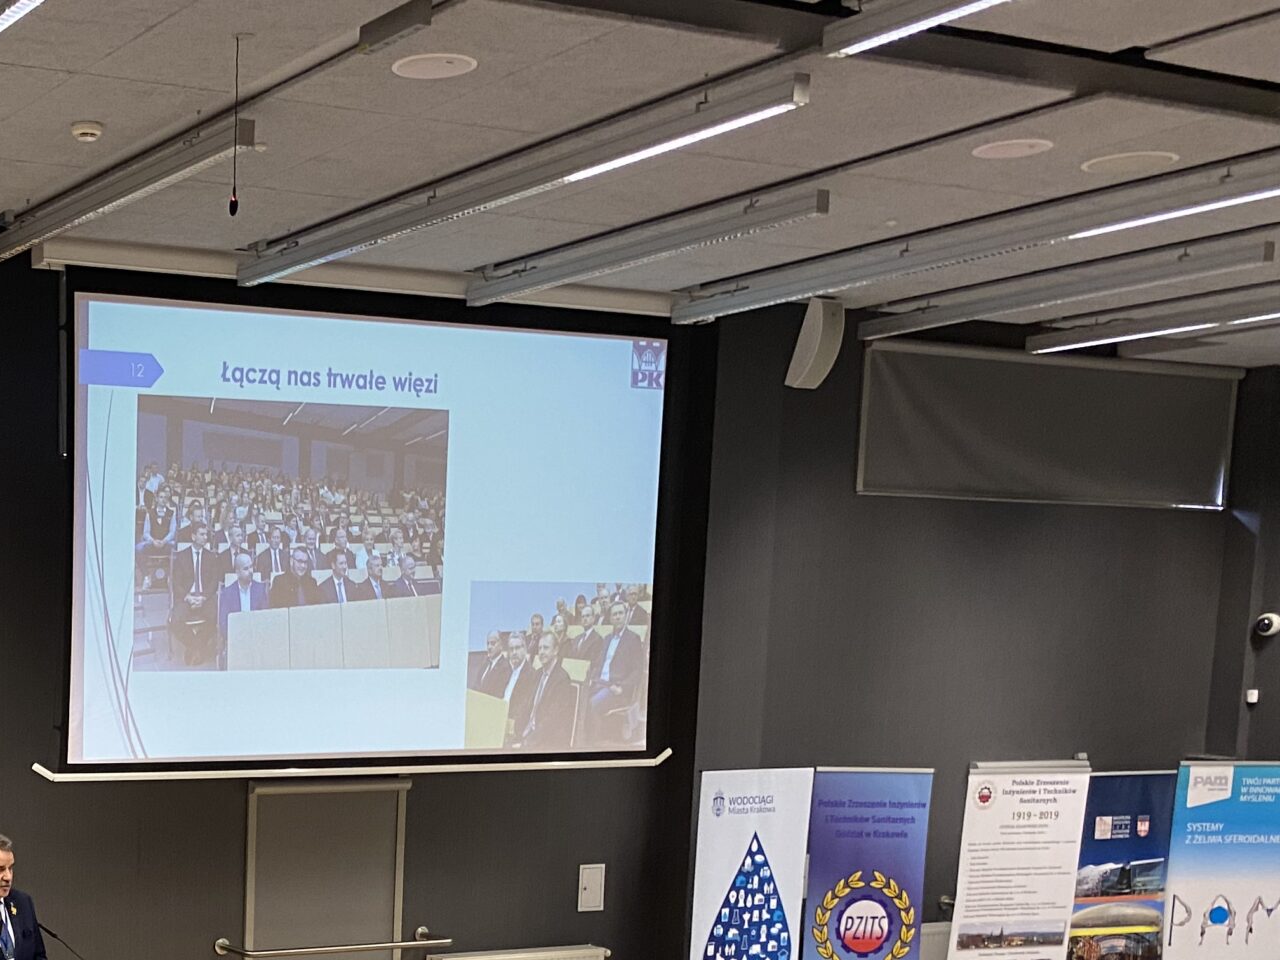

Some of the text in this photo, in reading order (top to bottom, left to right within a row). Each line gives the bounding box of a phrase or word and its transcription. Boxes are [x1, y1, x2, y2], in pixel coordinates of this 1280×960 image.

[129, 362, 145, 378] 12
[221, 361, 439, 397] Łączą nas trwałe więzi
[632, 370, 664, 388] PK
[728, 795, 774, 806] WODOCIĄGI
[728, 806, 749, 815] Miasta
[1012, 811, 1032, 820] 1919
[1038, 810, 1060, 819] 2019
[1186, 822, 1224, 832] SYSTEMY
[1185, 834, 1192, 844] Z
[1192, 834, 1223, 845] ŻELIWA
[843, 915, 886, 940] PZITS
